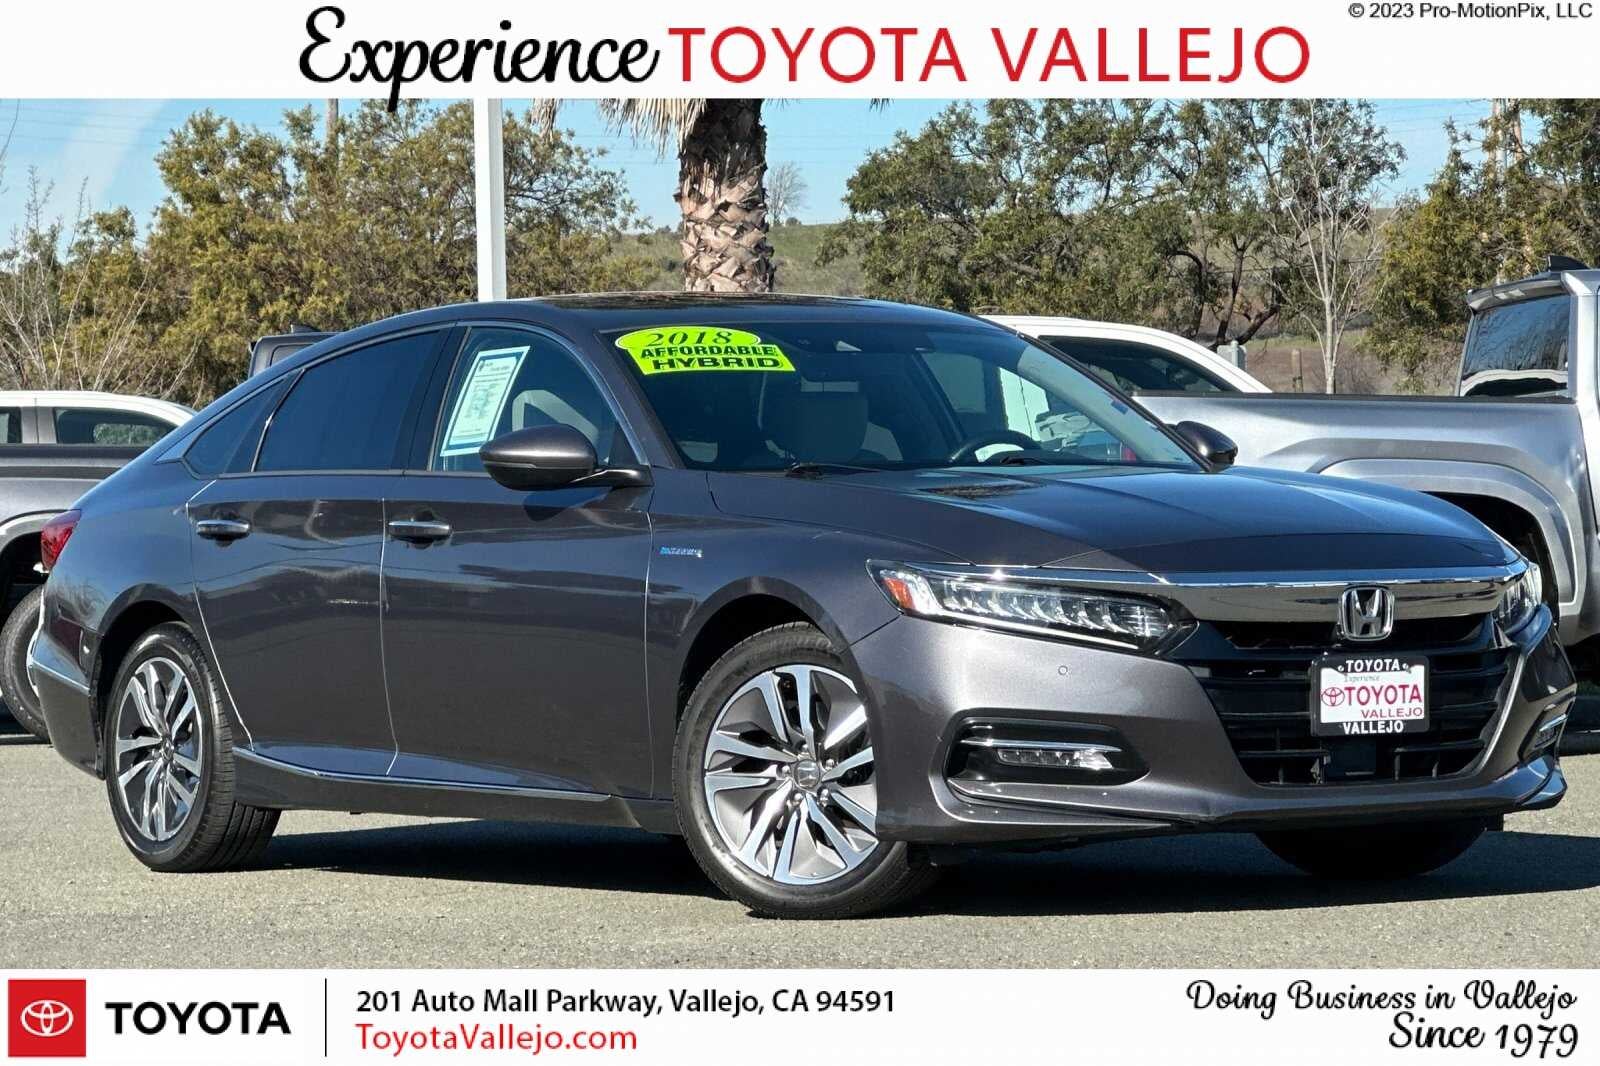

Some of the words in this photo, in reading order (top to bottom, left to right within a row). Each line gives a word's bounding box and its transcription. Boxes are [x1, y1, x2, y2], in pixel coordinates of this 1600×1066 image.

[646, 331, 733, 347] 2018
[641, 345, 775, 359] AFFORDABLE
[653, 356, 782, 370] HYBRID
[1345, 659, 1400, 673] TOYOTA
[1344, 684, 1423, 706] TOYOTA
[1360, 707, 1423, 719] VALLEJO
[1343, 720, 1404, 735] VALLEJO
